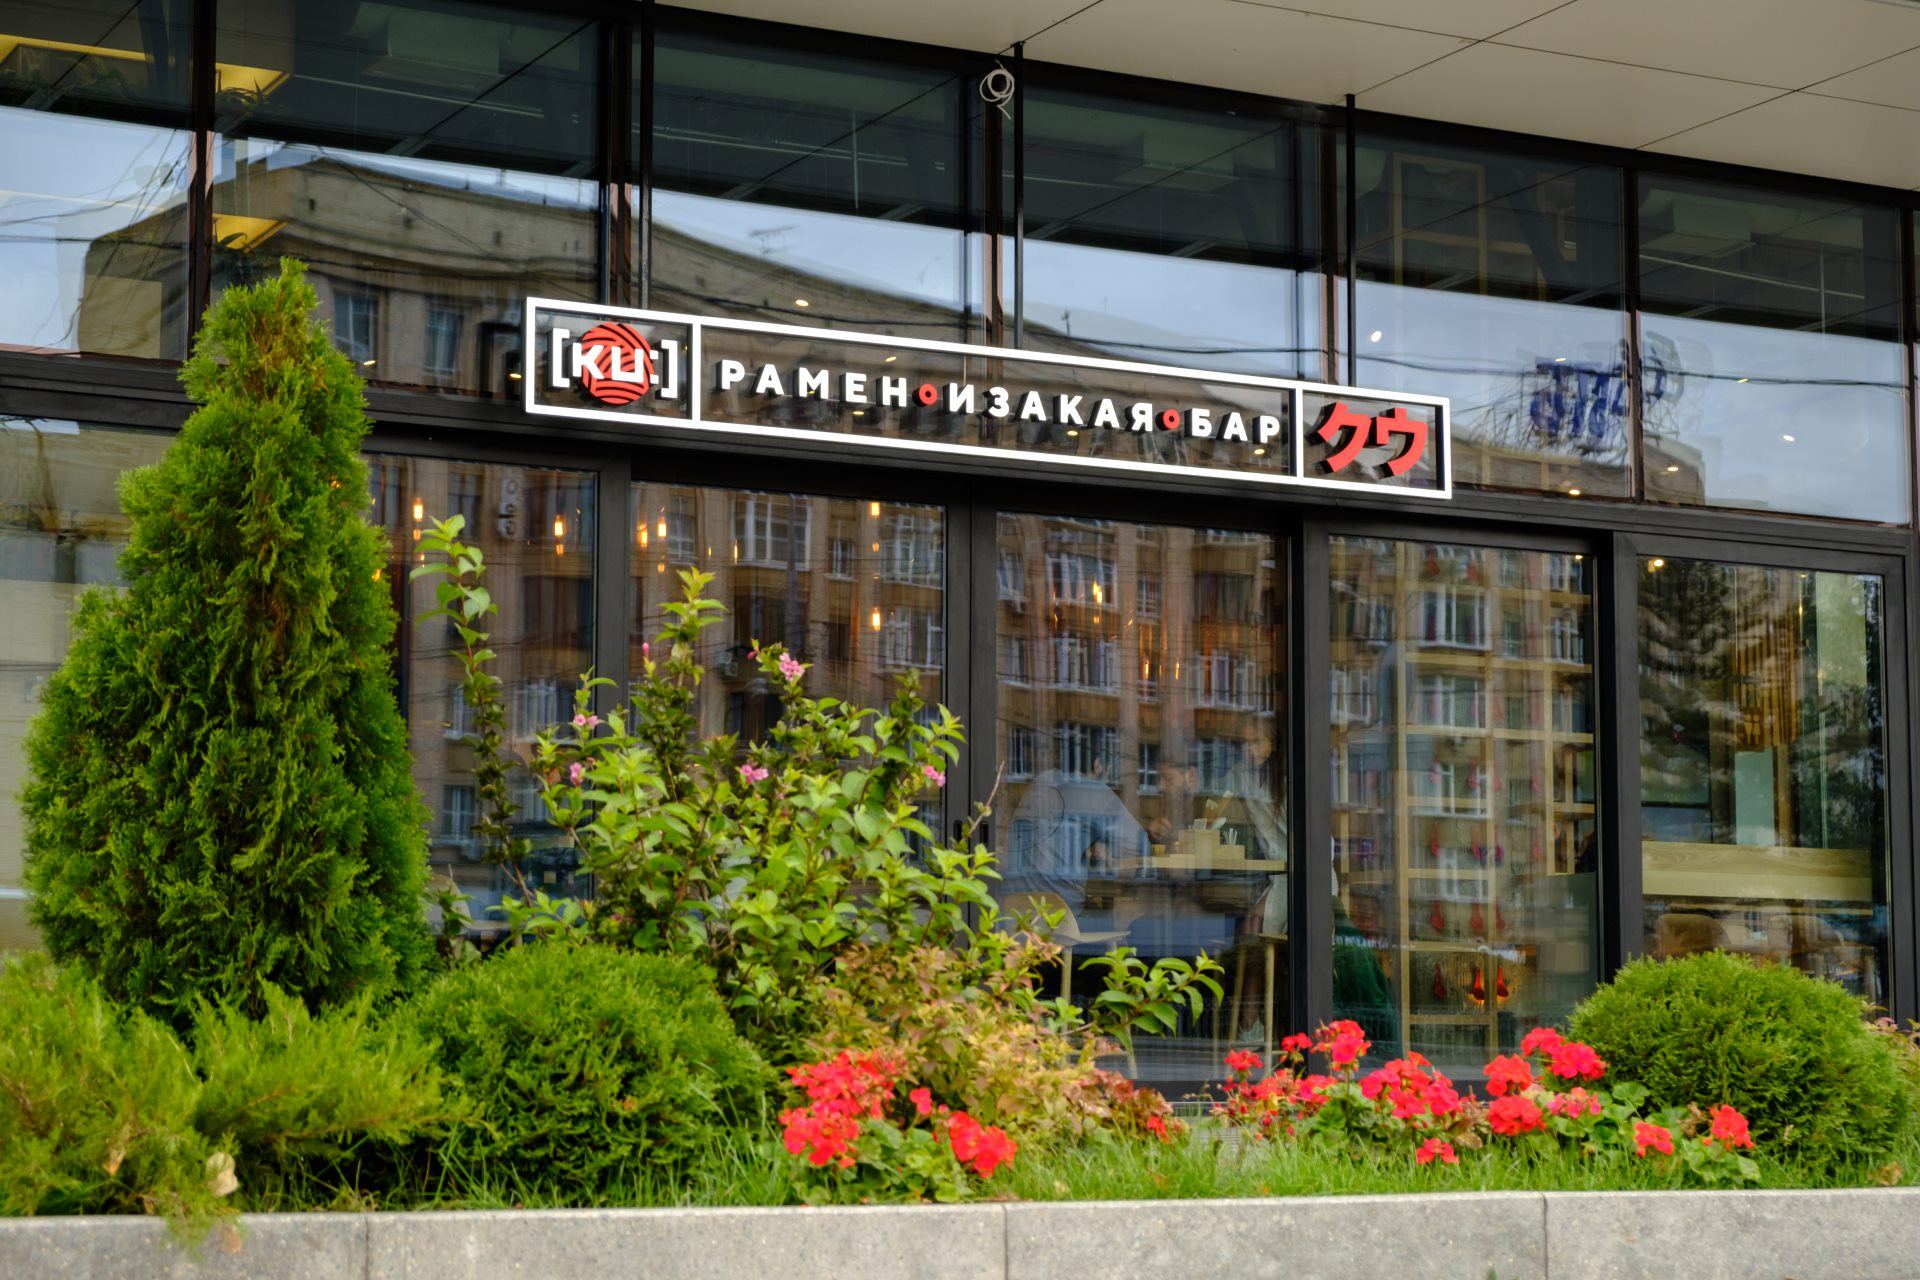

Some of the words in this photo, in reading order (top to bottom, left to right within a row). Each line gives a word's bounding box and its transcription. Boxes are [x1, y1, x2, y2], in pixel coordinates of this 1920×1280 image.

[721, 359, 907, 407] РАМЕН
[949, 382, 1153, 432] ИЗАКАЯ
[1191, 407, 1280, 444] БАР
[1318, 401, 1429, 476] クウ
